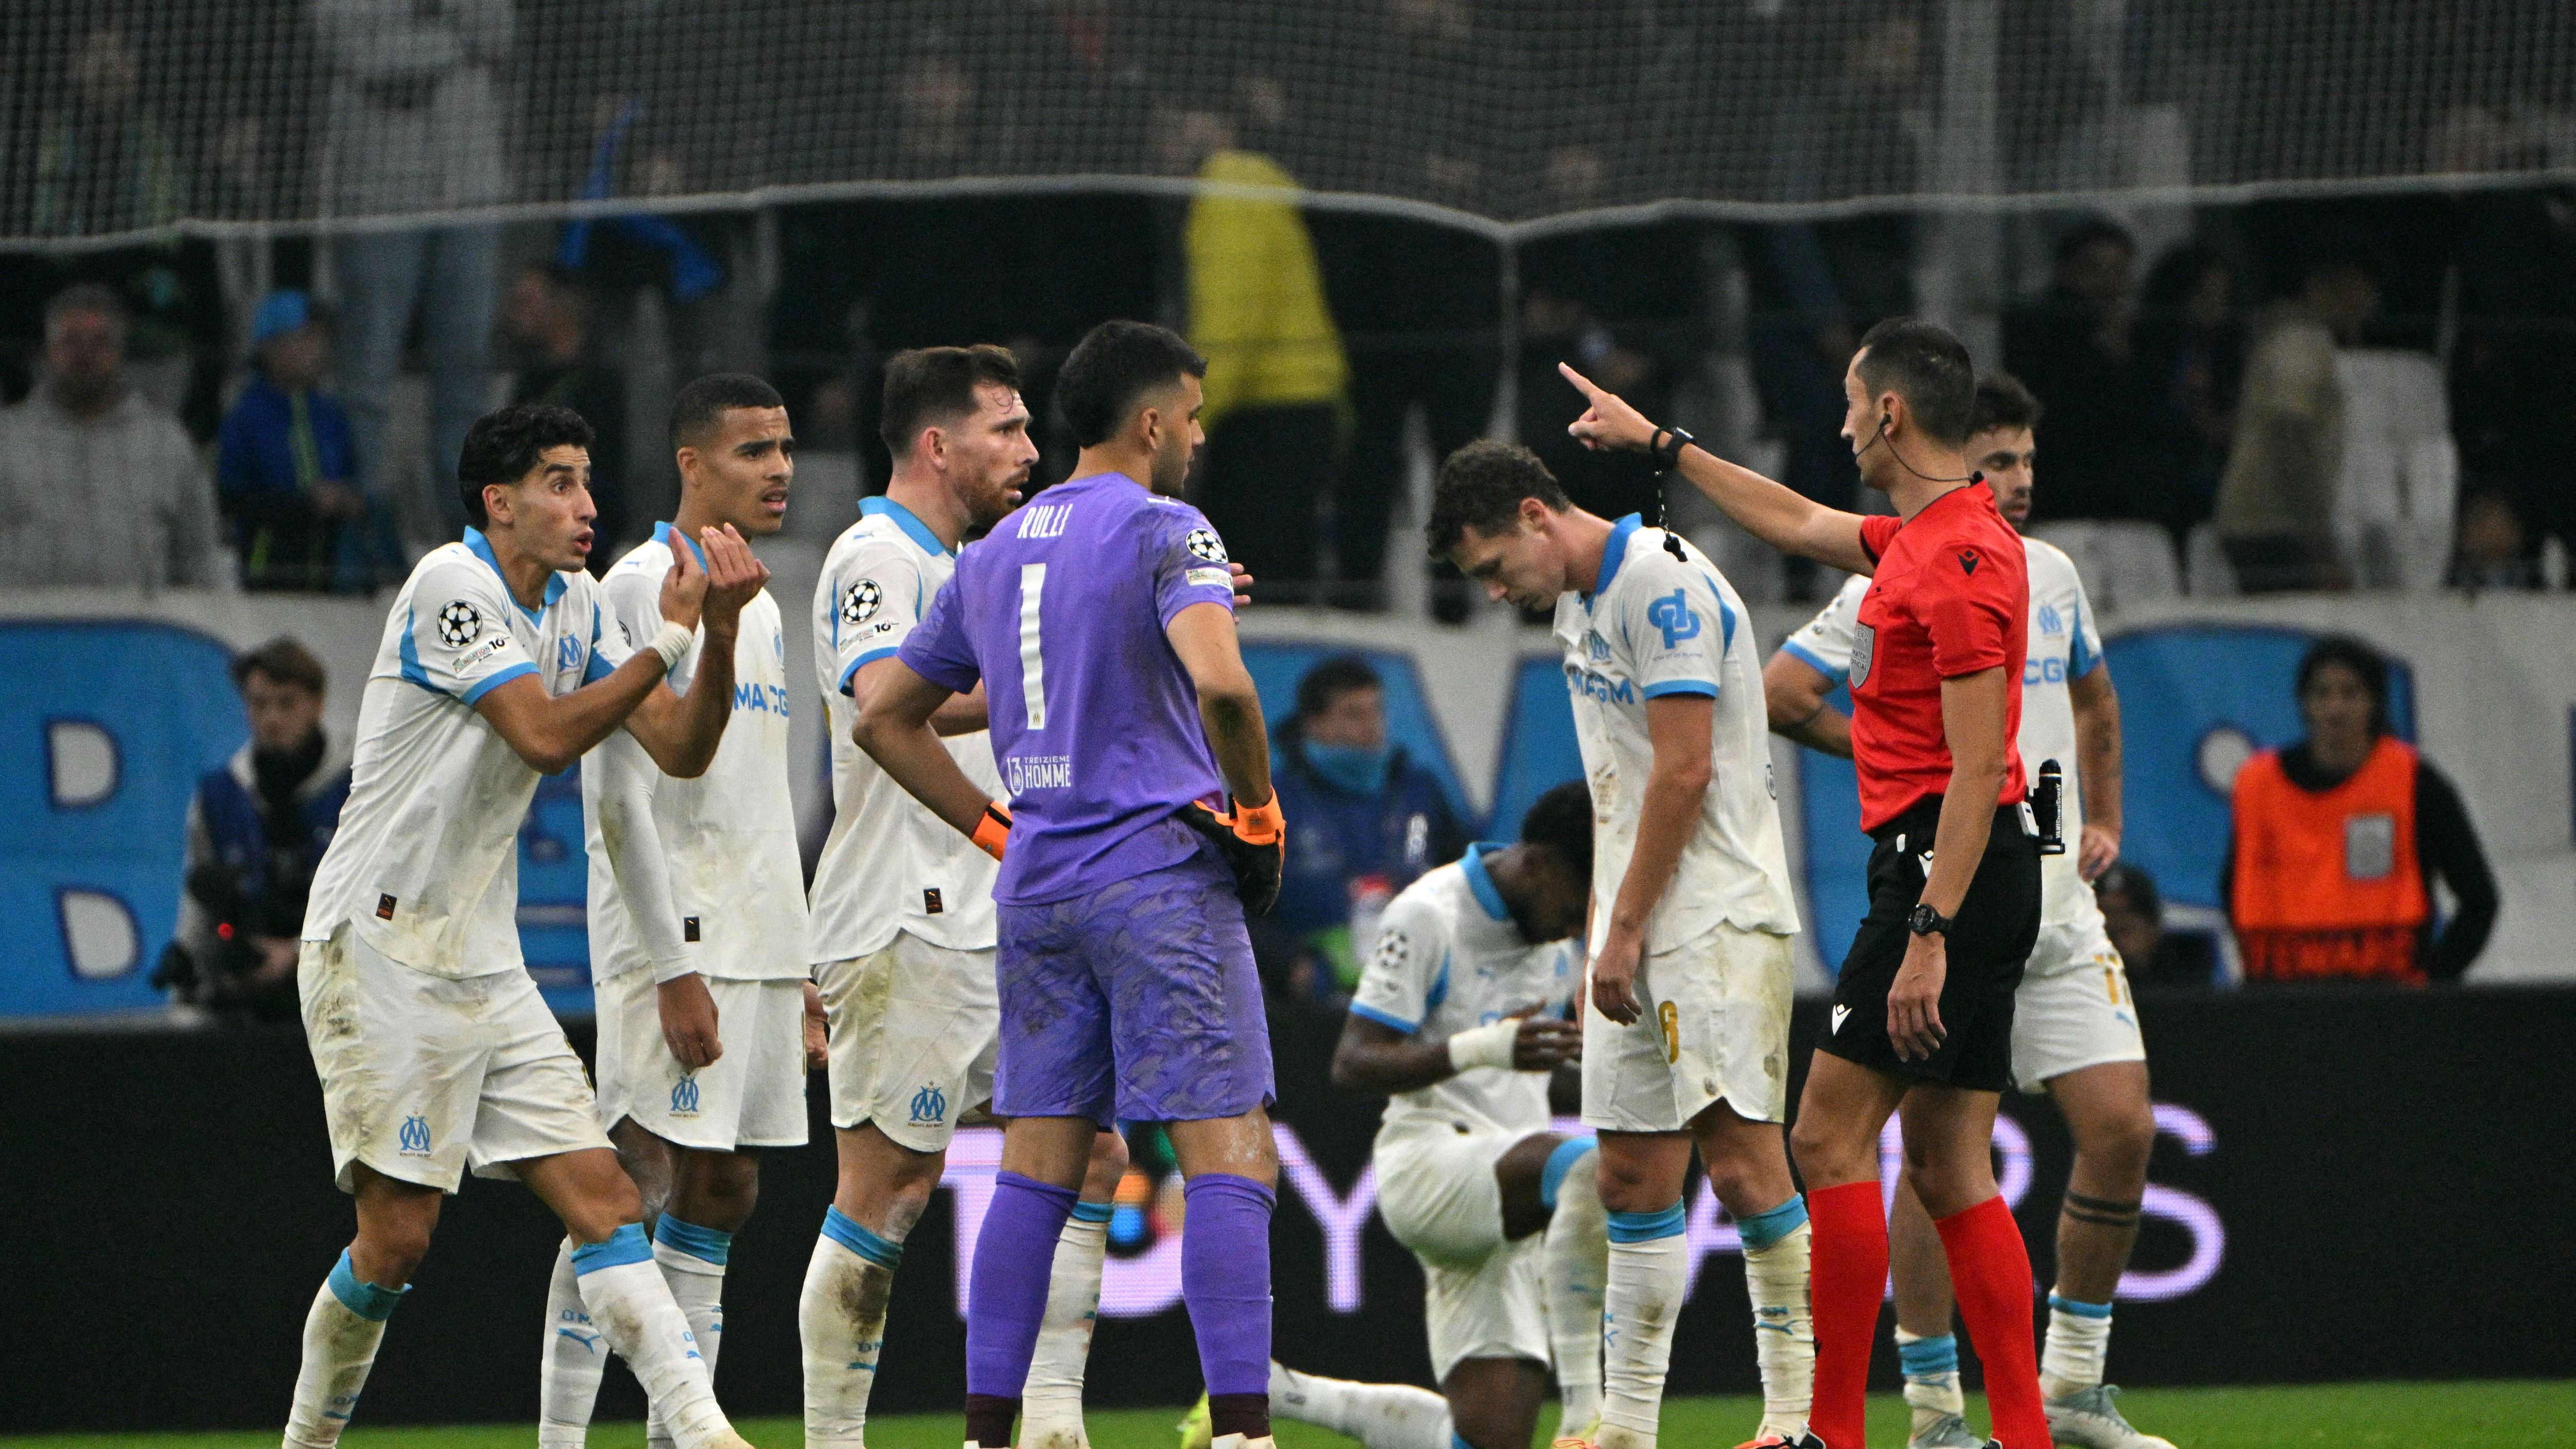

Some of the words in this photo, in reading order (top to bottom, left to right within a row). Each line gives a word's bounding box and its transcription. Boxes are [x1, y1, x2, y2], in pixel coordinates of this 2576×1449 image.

[1017, 503, 1073, 538] RULLI
[1020, 563, 1046, 729] 1
[1024, 755, 1070, 764] TREIZIEME
[1025, 763, 1071, 788] HOMME
